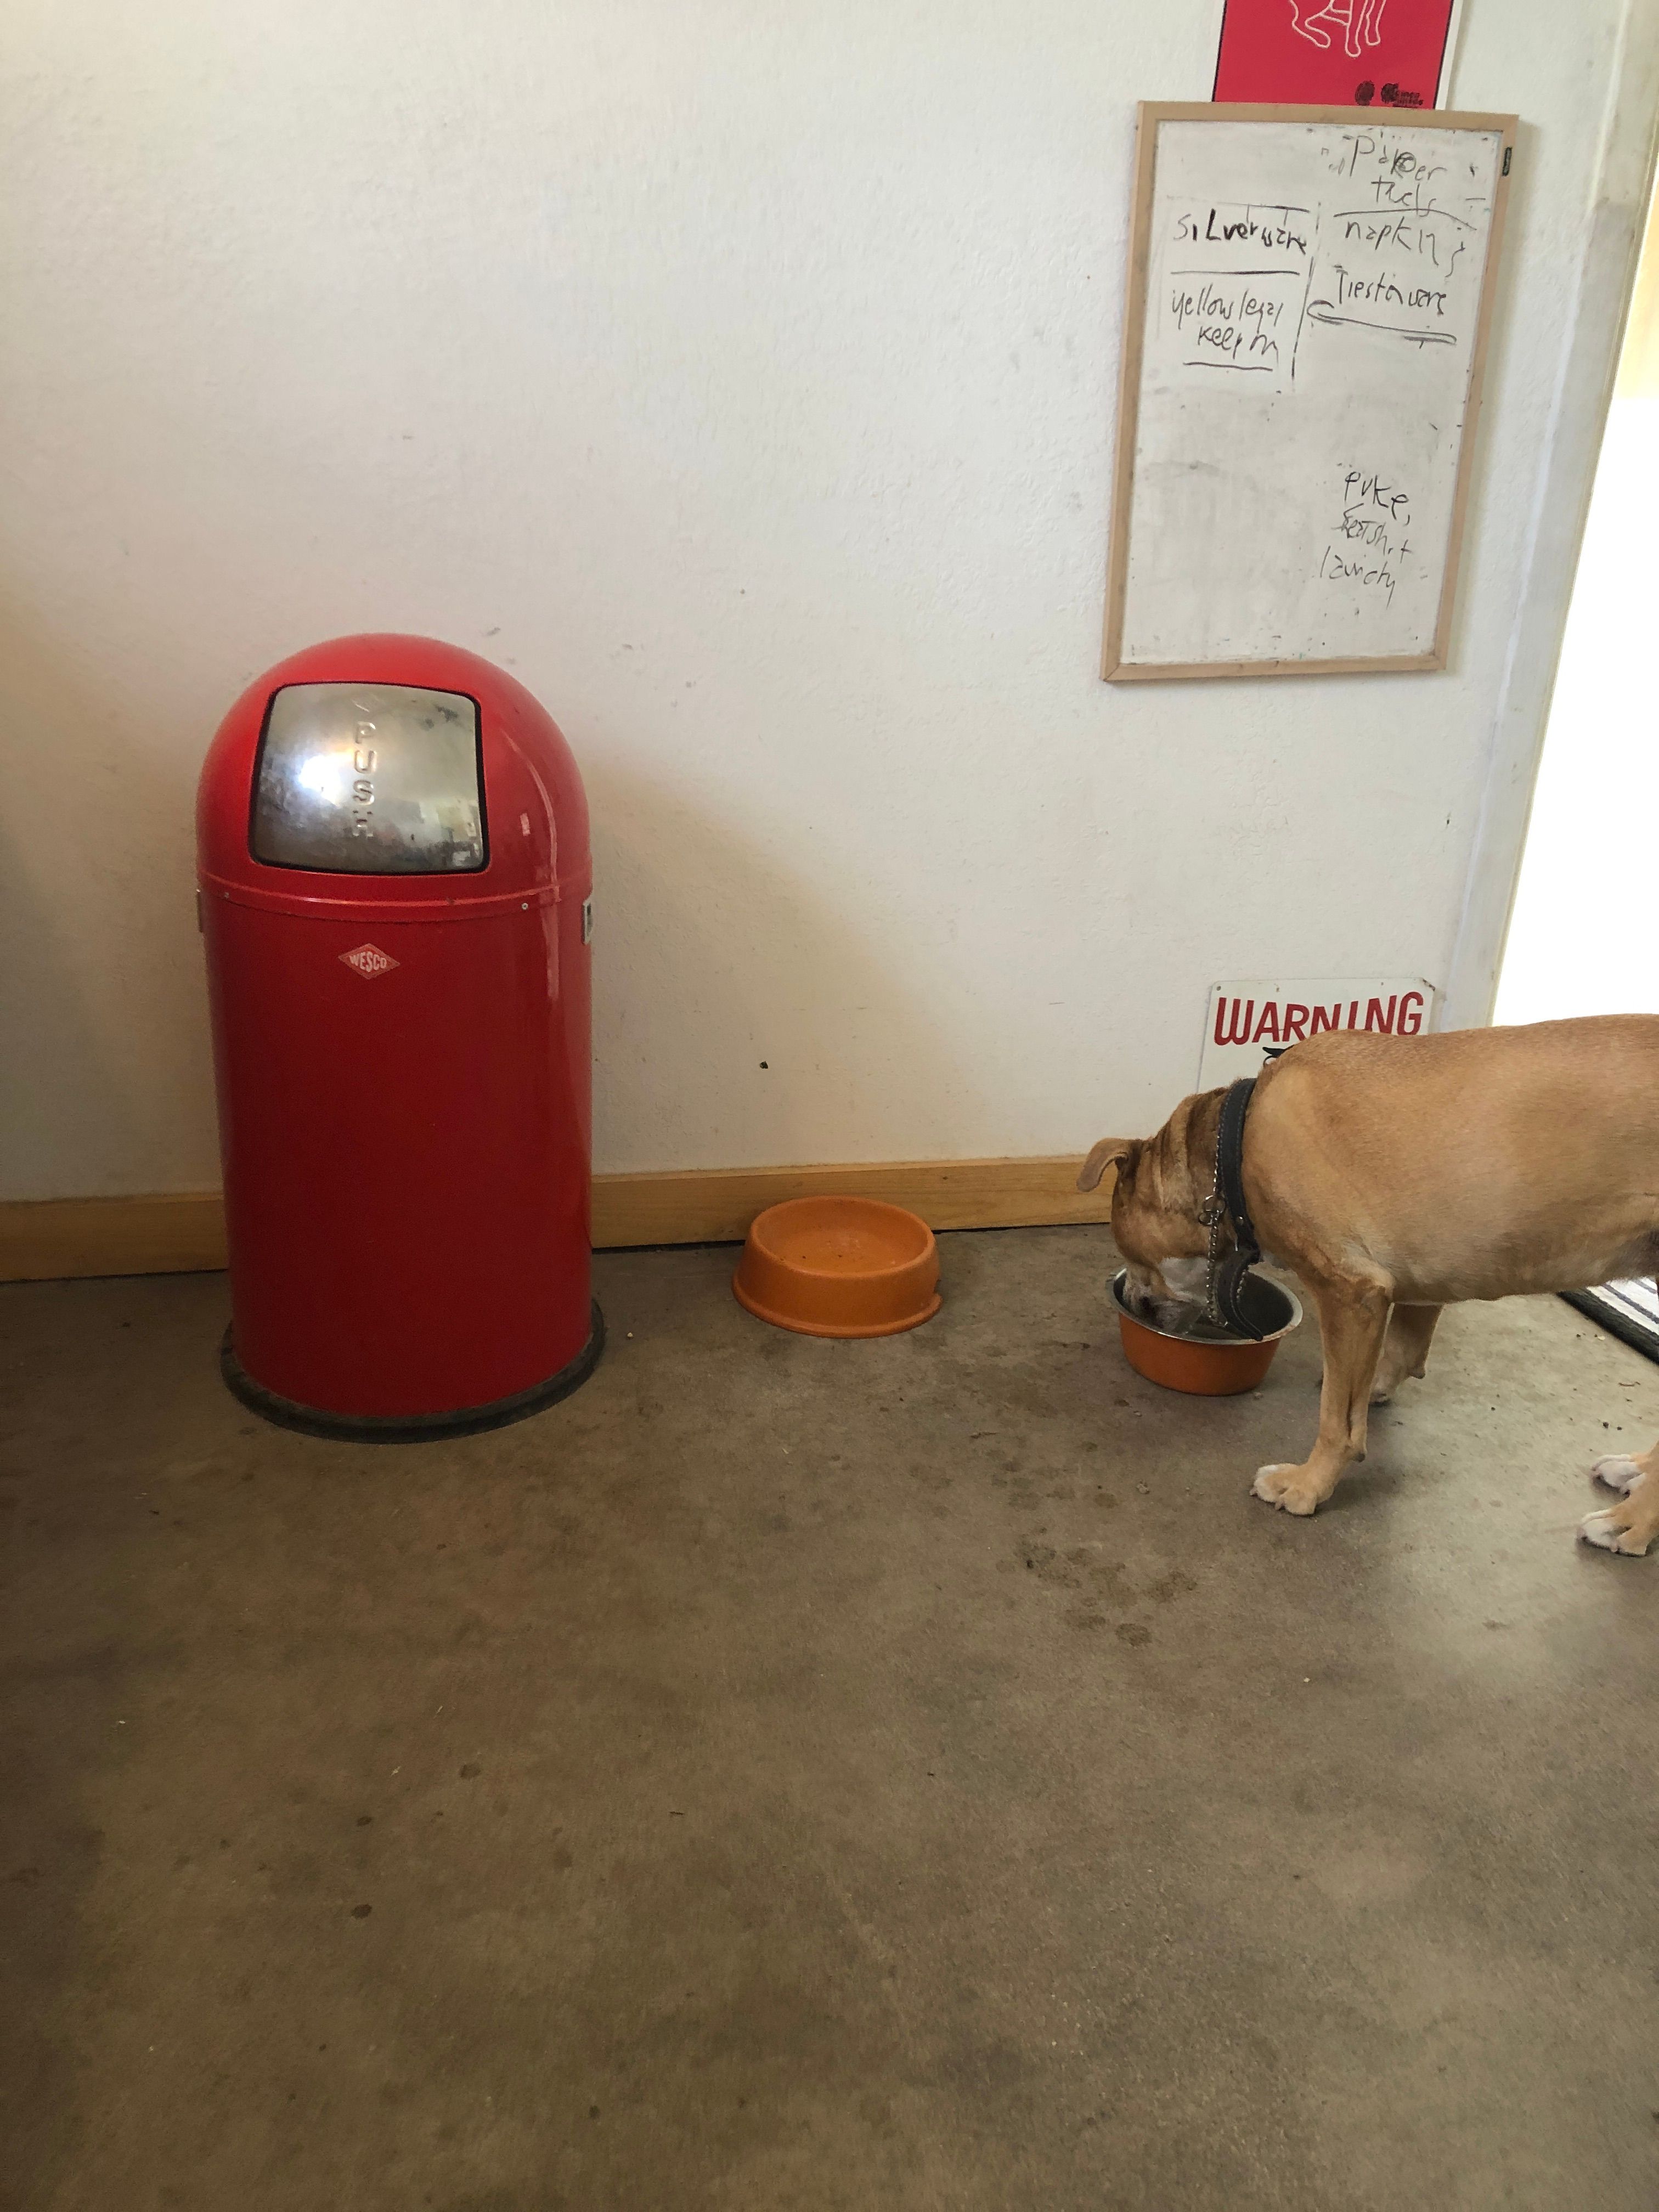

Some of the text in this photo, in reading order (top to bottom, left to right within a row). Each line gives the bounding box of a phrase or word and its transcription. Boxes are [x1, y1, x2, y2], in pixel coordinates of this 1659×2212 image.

[353, 720, 377, 838] PUSH
[349, 951, 387, 973] WESCO
[1214, 991, 1424, 1046] WARNING
